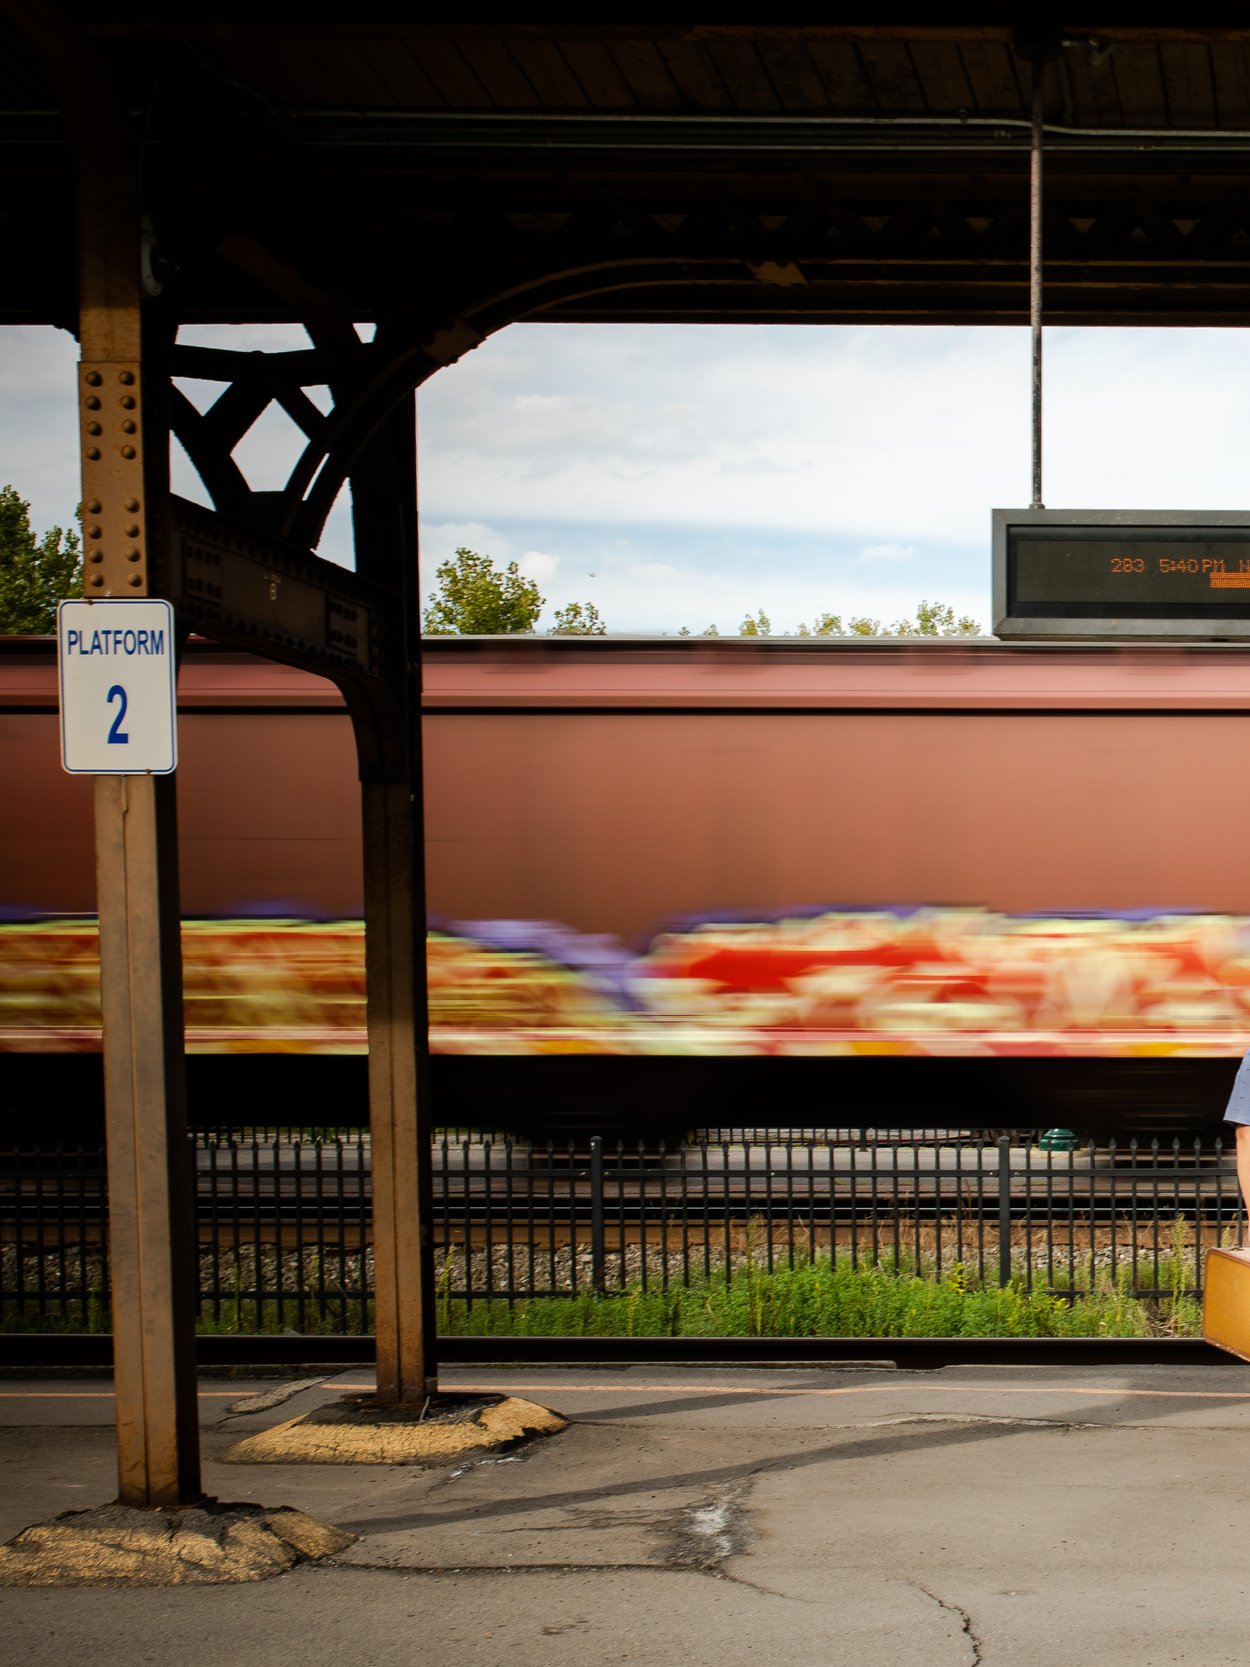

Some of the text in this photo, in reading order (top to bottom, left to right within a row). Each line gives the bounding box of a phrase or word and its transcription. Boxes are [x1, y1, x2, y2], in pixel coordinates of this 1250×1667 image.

[1110, 558, 1145, 573] 283
[1159, 558, 1199, 573] 5:40
[1202, 559, 1226, 573] PM
[67, 629, 165, 656] PLATFORM
[106, 684, 129, 744] 2
